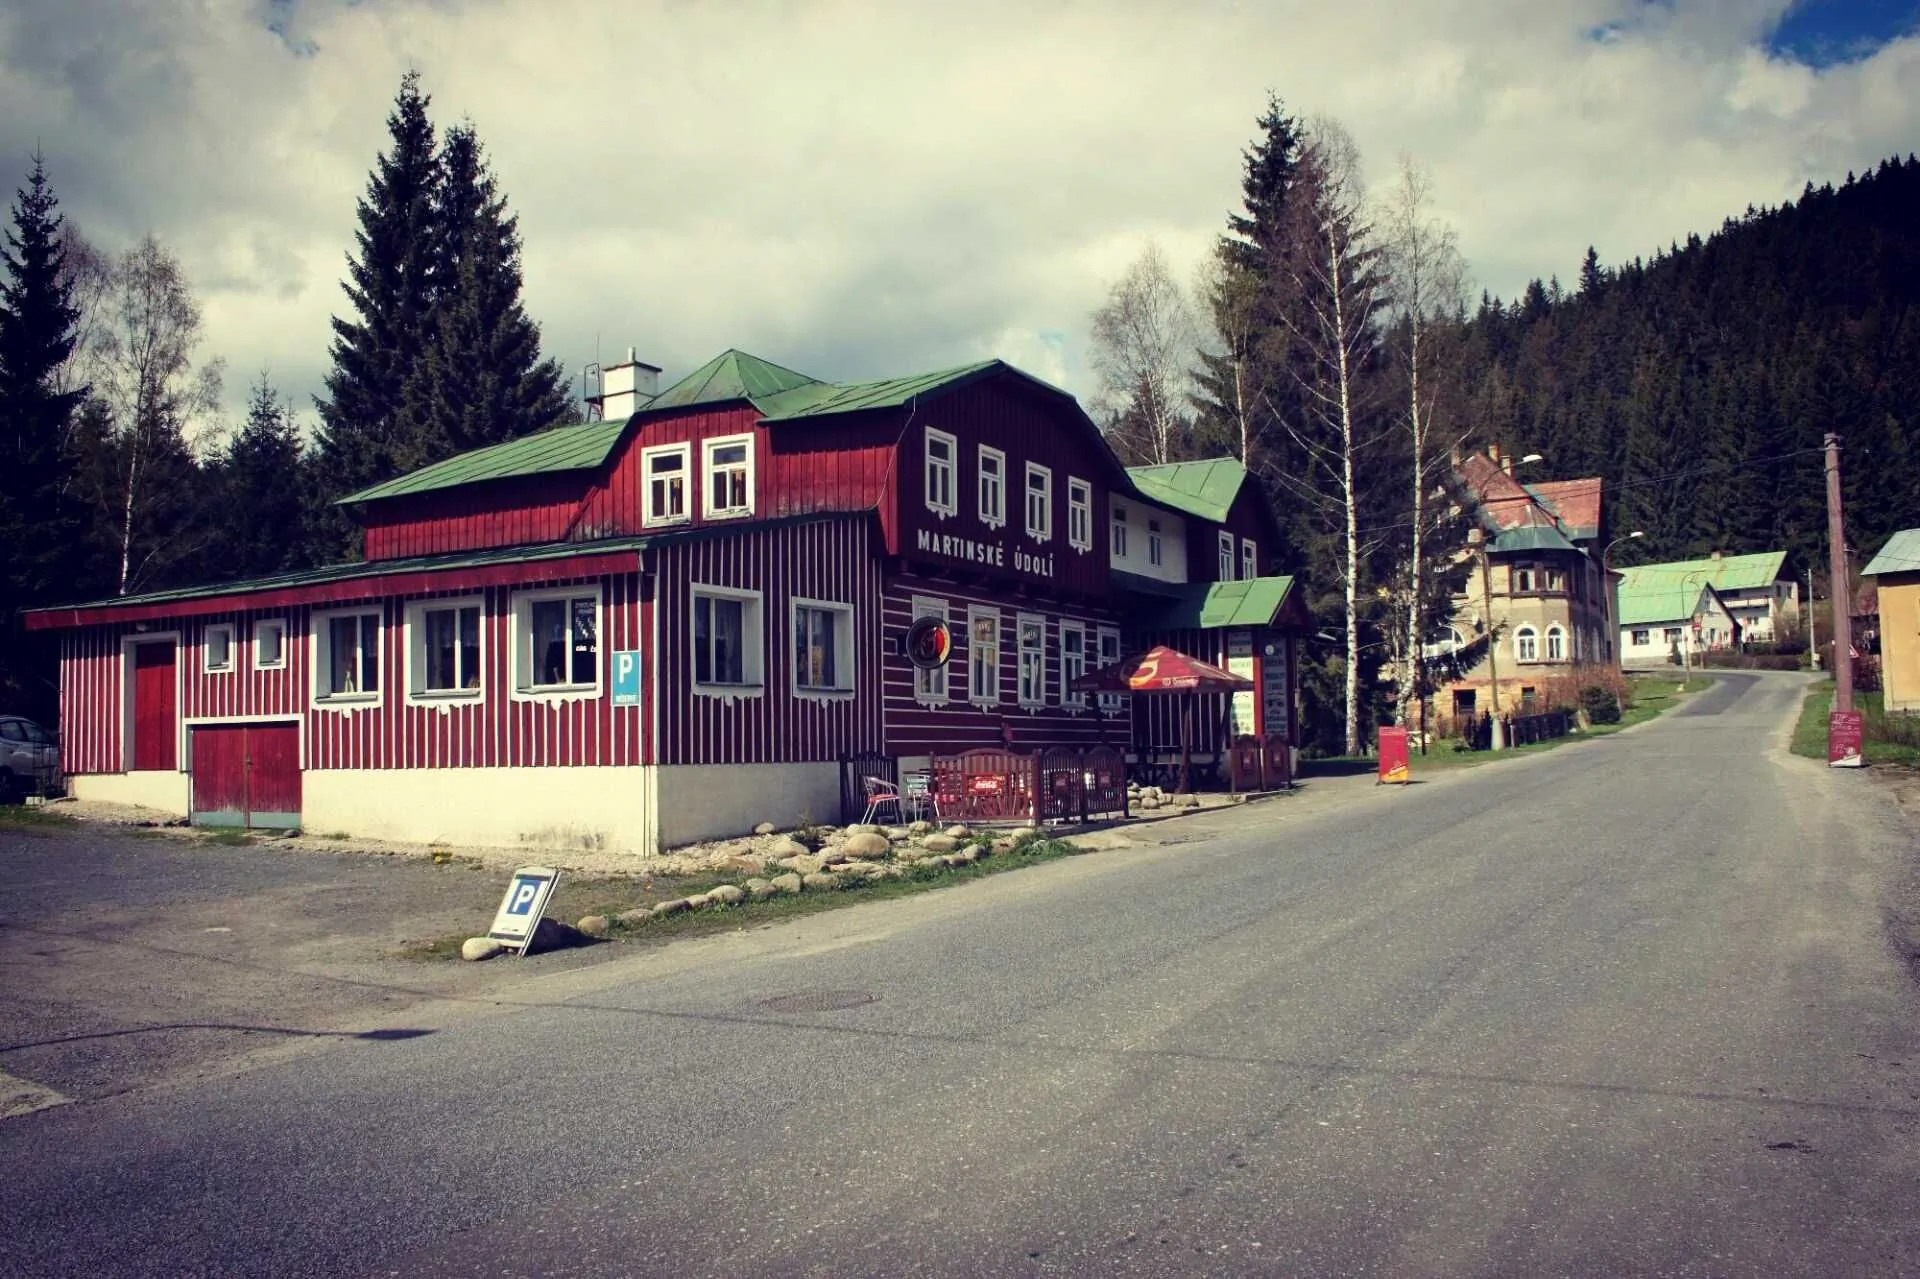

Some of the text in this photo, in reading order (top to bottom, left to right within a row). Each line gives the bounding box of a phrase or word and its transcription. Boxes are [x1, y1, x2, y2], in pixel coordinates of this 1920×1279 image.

[917, 528, 1054, 578] MARTINSKÉ ÚDOLÍ
[619, 654, 633, 684] P
[511, 884, 536, 913] P
